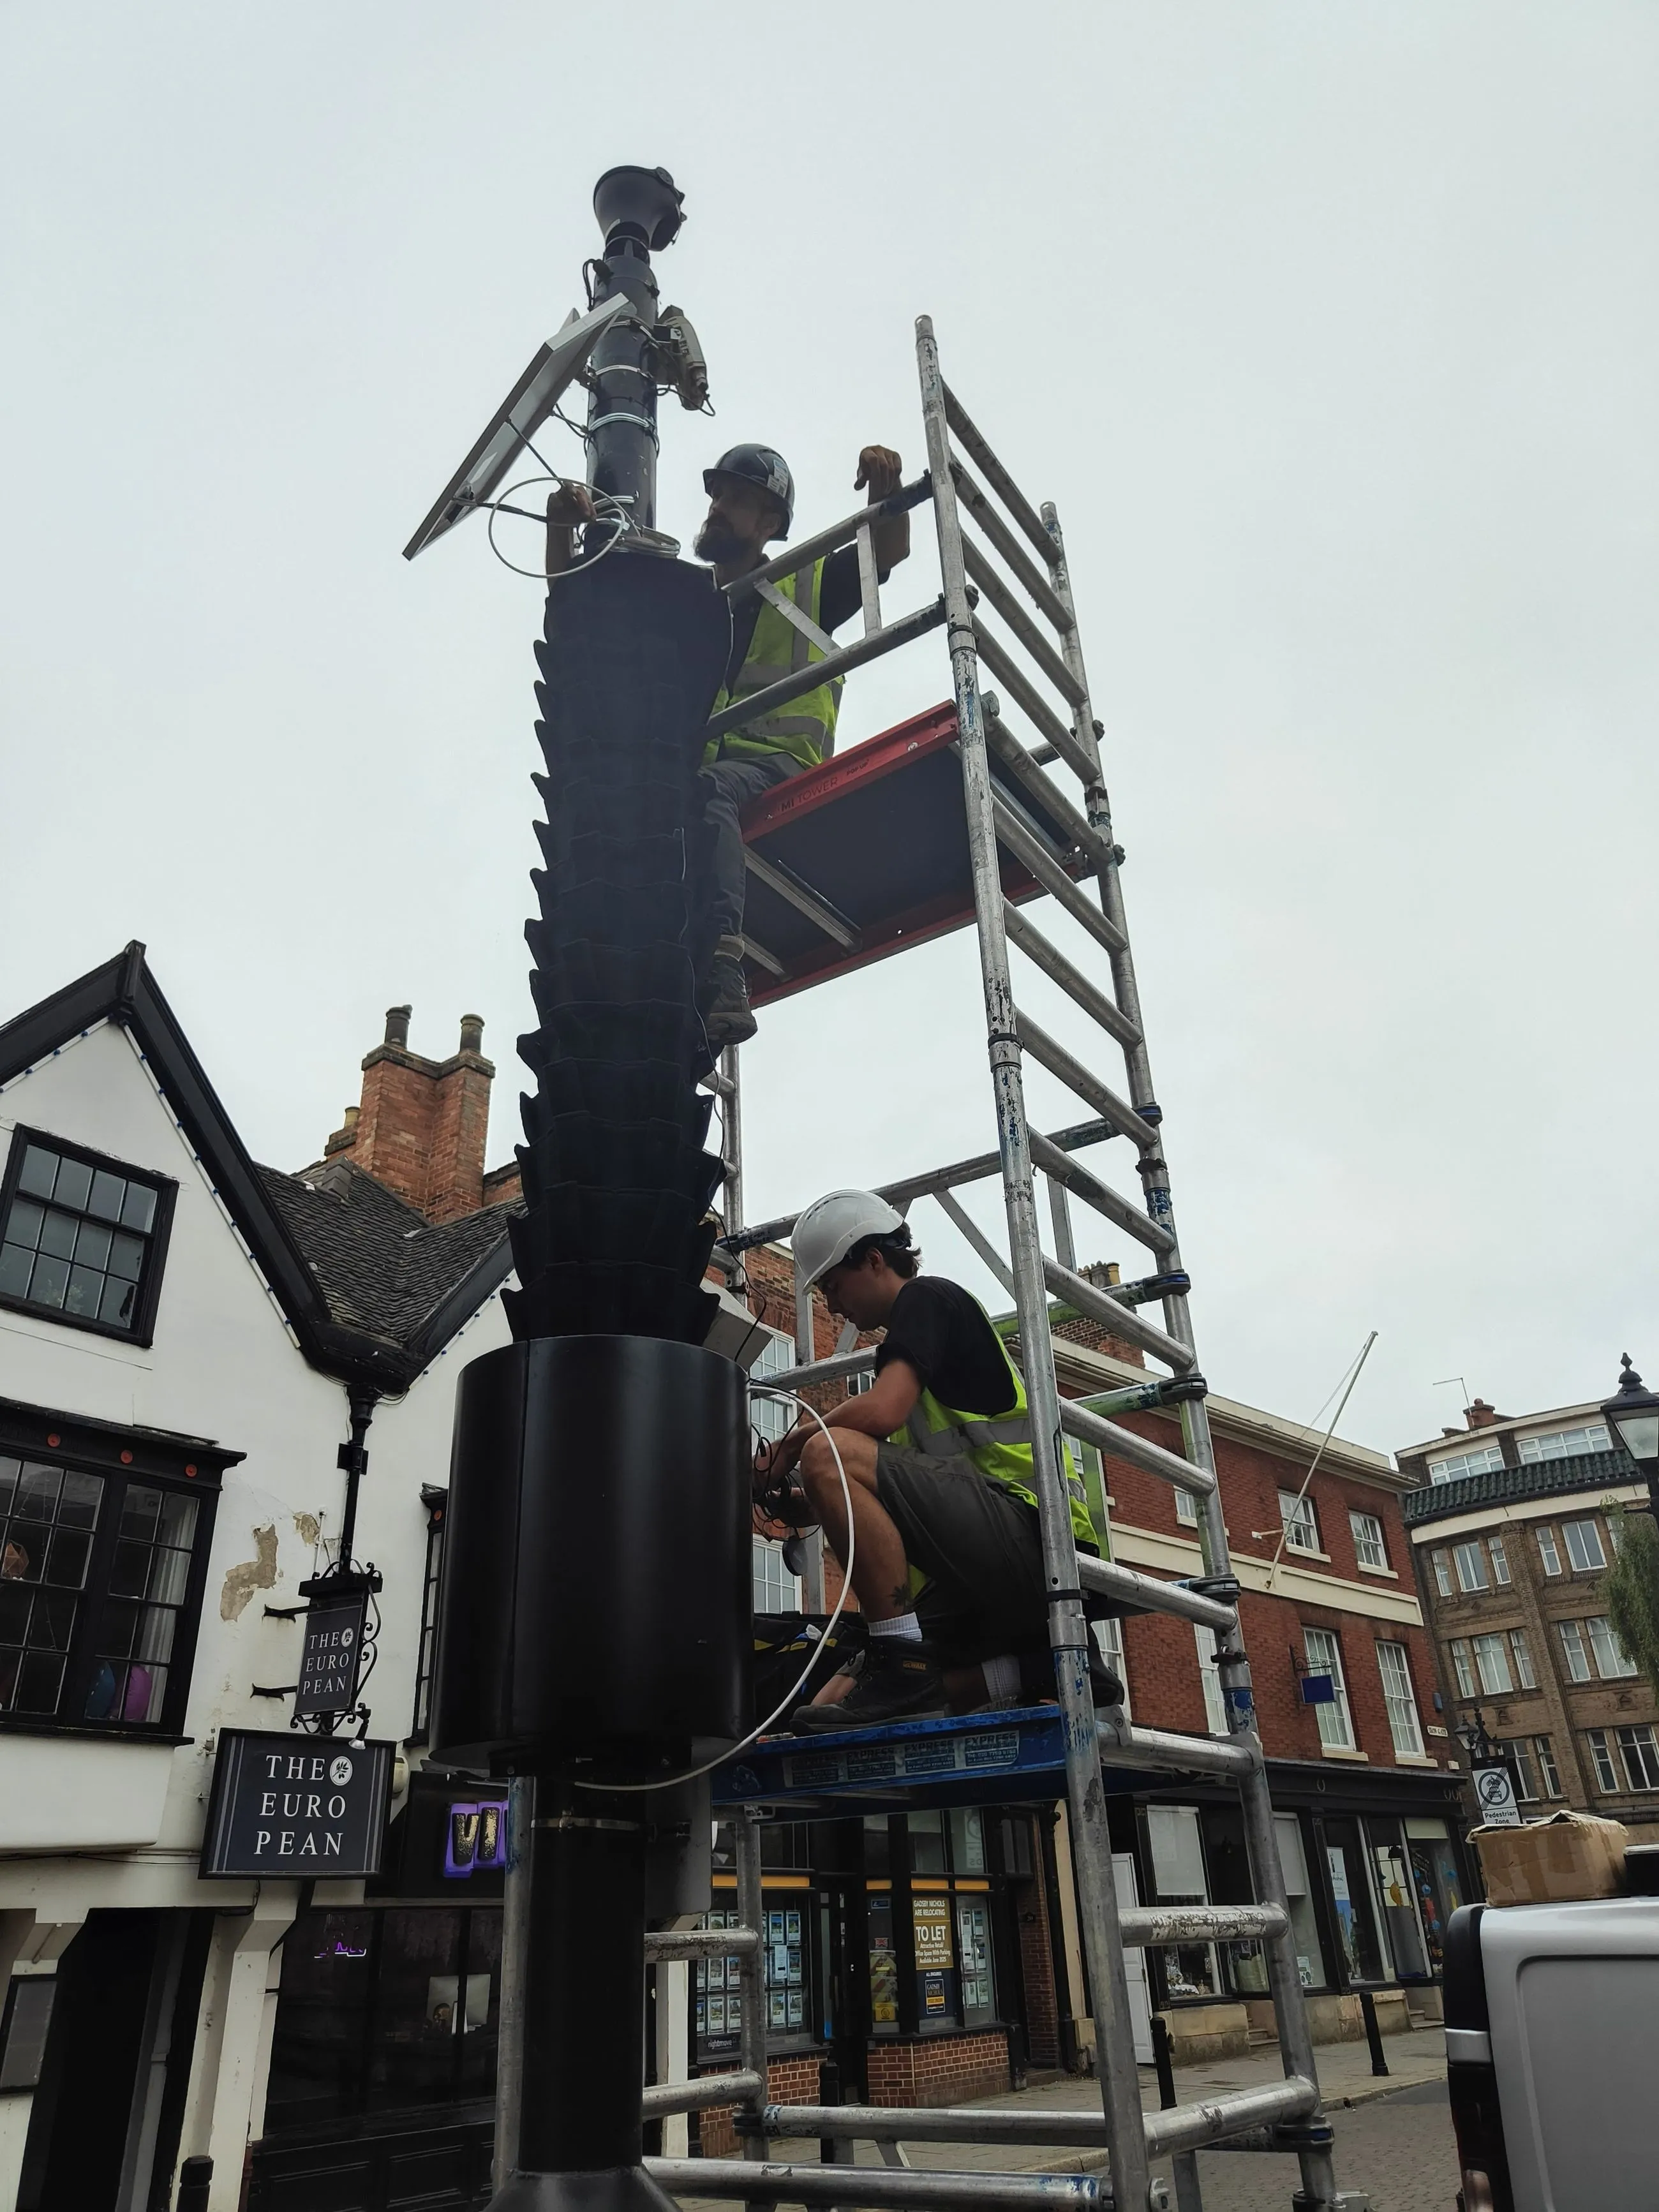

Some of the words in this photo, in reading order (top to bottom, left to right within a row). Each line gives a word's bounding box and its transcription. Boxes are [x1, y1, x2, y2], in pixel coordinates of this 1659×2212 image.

[798, 777, 838, 802] TOWER
[310, 1631, 339, 1649] THE
[306, 1652, 349, 1672] EURO
[302, 1675, 346, 1695] PEAN
[904, 1740, 955, 1753] EXPRESS
[965, 1732, 1016, 1746] EXPRESS
[265, 1755, 325, 1781] THE
[259, 1792, 346, 1818] EURO
[1485, 1810, 1517, 1818] Pedestrian
[253, 1830, 343, 1856] PEAN
[452, 1806, 509, 1866] VI
[916, 1926, 929, 1941] TO
[931, 1926, 946, 1941] LET
[708, 2039, 732, 2049] rightmove
